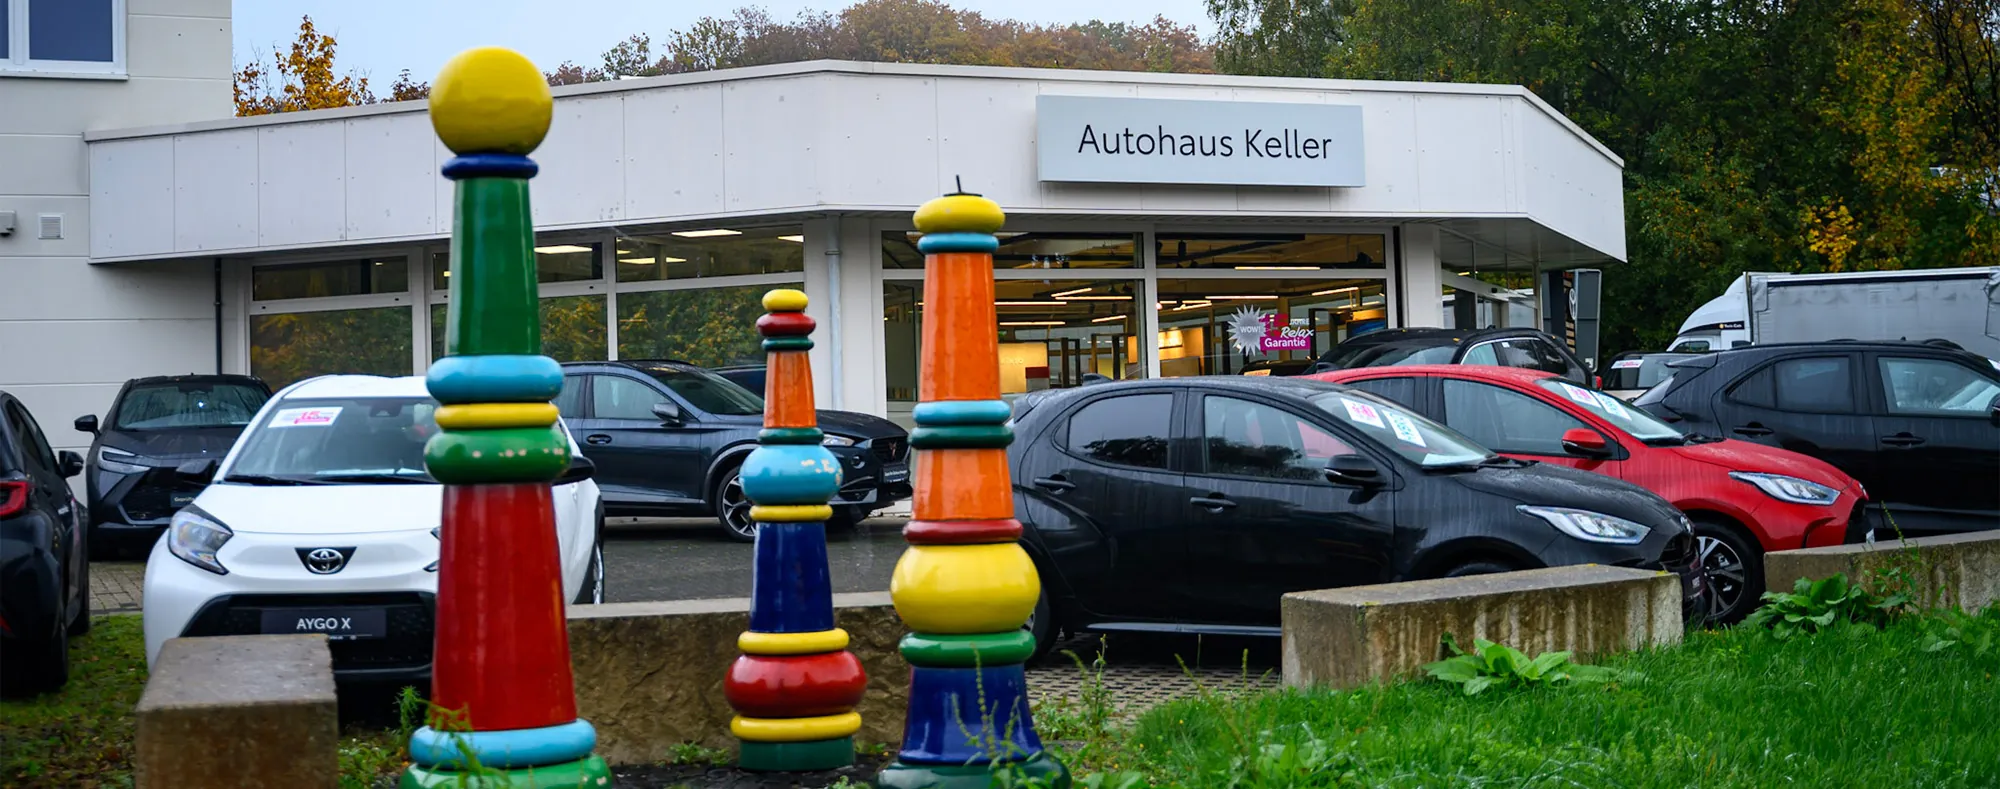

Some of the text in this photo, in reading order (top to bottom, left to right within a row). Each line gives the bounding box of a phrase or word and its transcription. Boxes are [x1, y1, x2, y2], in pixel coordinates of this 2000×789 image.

[1077, 124, 1332, 159] Autohaus Keller
[1281, 326, 1314, 338] Relax
[1264, 337, 1306, 347] Garantie
[296, 617, 352, 630] AYGO X
